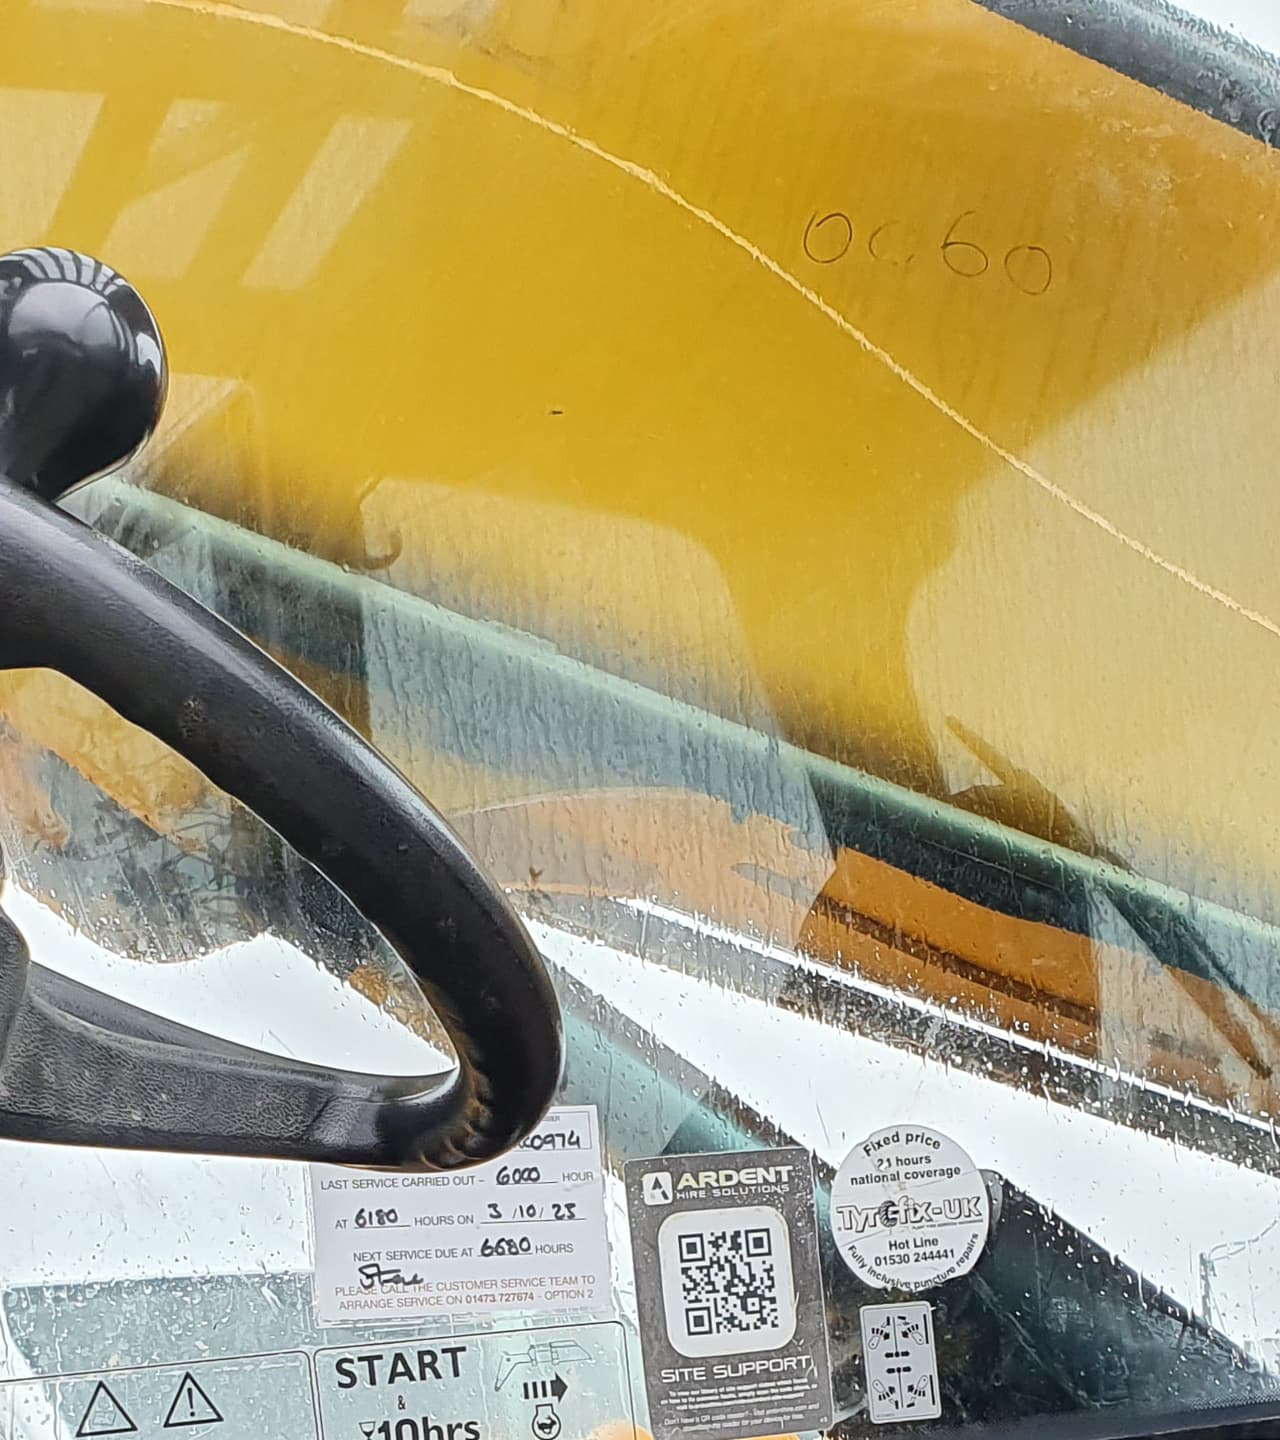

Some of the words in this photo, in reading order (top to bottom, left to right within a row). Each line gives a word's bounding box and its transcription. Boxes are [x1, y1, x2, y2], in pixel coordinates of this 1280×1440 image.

[863, 1131, 900, 1157] Fixed
[905, 1131, 941, 1150] price
[896, 1155, 932, 1168] hours
[320, 1179, 349, 1190] LAST
[351, 1178, 399, 1189] SERVICE
[401, 1176, 450, 1188] CARRIED
[452, 1175, 476, 1186] OUT
[496, 1165, 541, 1185] 6000
[562, 1171, 594, 1182] HOUR
[676, 1165, 794, 1190] ARDENT
[851, 1170, 901, 1186] national
[904, 1165, 961, 1181] coverage
[676, 1189, 707, 1201] HIRE
[712, 1183, 791, 1197] SOLUTIONS
[335, 1219, 349, 1230] AT
[355, 1207, 399, 1228] 6180
[414, 1215, 455, 1226] HOURS
[457, 1215, 475, 1225] ON
[353, 1251, 383, 1262] NEXT
[385, 1249, 433, 1261] SERVICE
[434, 1248, 458, 1259] DUE
[460, 1247, 474, 1258] AT
[535, 1243, 574, 1254] HOURS
[888, 1240, 910, 1251] Hot
[913, 1237, 939, 1249] Line
[847, 1244, 868, 1270] Fully
[867, 1266, 911, 1290] inclusive
[914, 1266, 956, 1291] puncture
[956, 1232, 979, 1268] repairs
[874, 1252, 910, 1267] 01530
[914, 1249, 955, 1263] 244441
[335, 1286, 377, 1297] PLEASE
[380, 1283, 408, 1295] CALL
[412, 1281, 433, 1293] THE
[436, 1279, 498, 1292] CUSTOMER
[500, 1277, 546, 1288] SERVICE
[549, 1275, 578, 1286] TEAM
[580, 1275, 596, 1285] TO
[339, 1298, 394, 1310] ARRANGE
[396, 1296, 444, 1308] SERVICE
[446, 1295, 463, 1306] ON
[465, 1294, 496, 1304] 01473
[499, 1292, 534, 1302] 727674
[544, 1290, 584, 1300] OPTION
[587, 1289, 593, 1298] 2
[335, 1346, 467, 1389] START
[661, 1367, 706, 1383] SITE
[713, 1355, 811, 1379] SUPPORT
[398, 1395, 406, 1410] &
